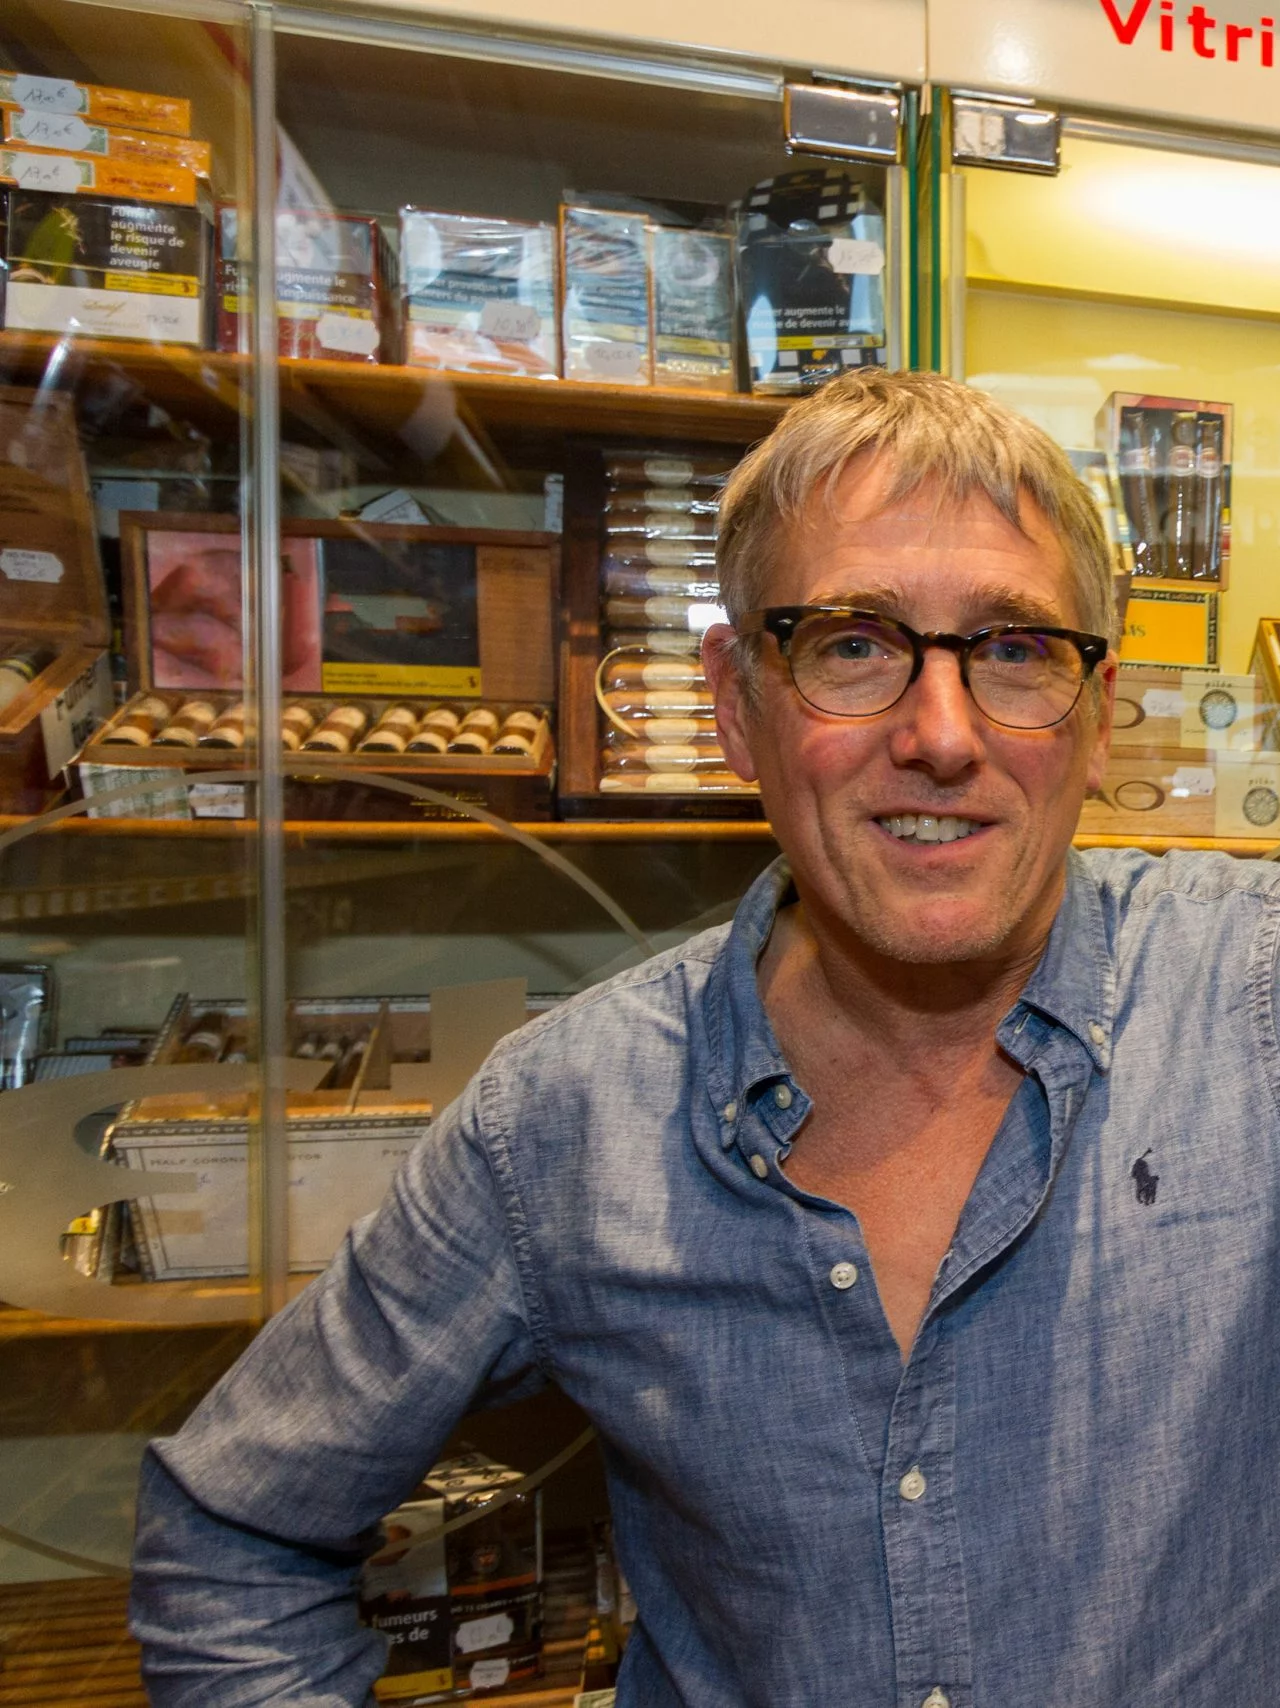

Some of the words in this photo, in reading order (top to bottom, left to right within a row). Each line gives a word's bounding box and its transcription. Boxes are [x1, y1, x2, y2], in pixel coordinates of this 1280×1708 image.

[111, 220, 176, 234] augmente
[110, 231, 122, 241] le
[125, 233, 166, 249] risque
[168, 236, 185, 248] de
[109, 244, 159, 257] devenir
[109, 256, 160, 270] aveugle
[784, 306, 834, 319] augmente
[836, 304, 845, 315] le
[785, 317, 798, 328] de
[800, 316, 836, 328] devenir
[408, 1626, 430, 1643] de
